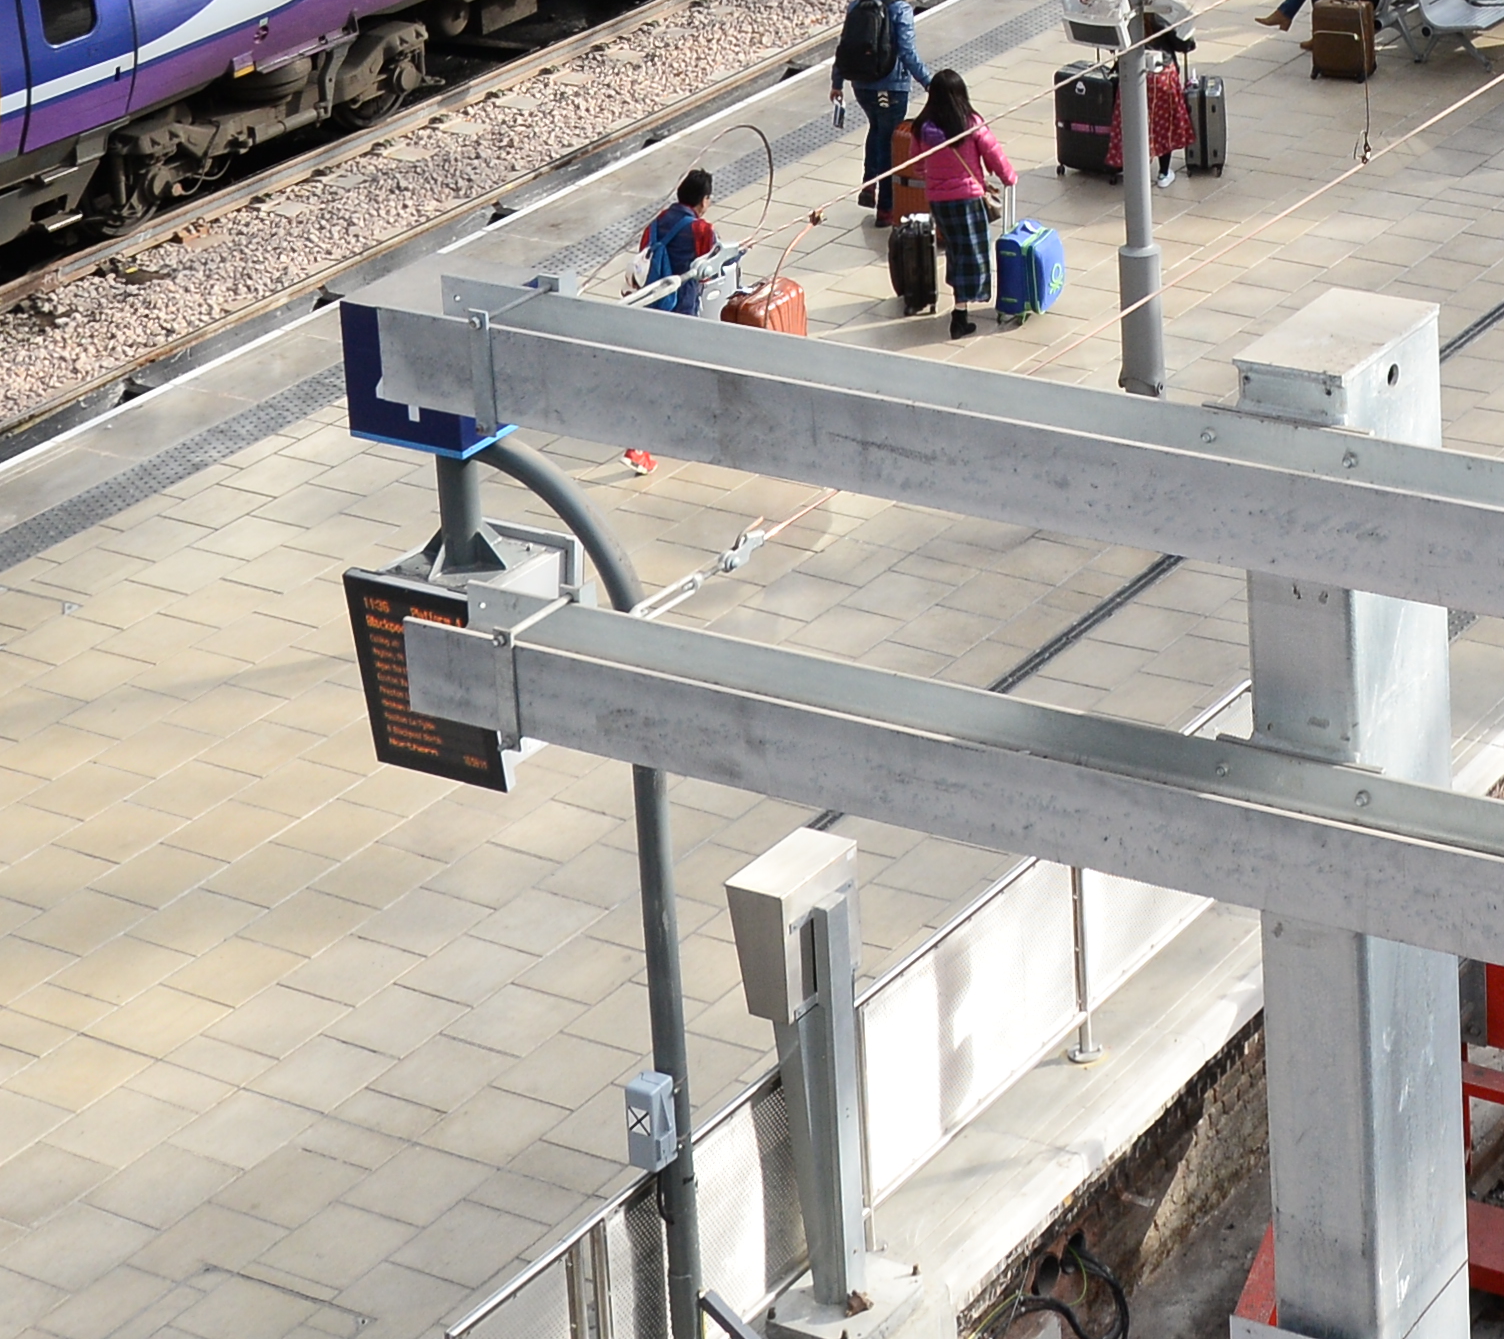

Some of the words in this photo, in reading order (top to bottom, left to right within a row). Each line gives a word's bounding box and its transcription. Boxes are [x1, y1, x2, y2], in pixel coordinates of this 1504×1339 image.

[366, 614, 404, 635] Blackpoo
[409, 606, 451, 627] Platform
[388, 737, 440, 757] Northern
